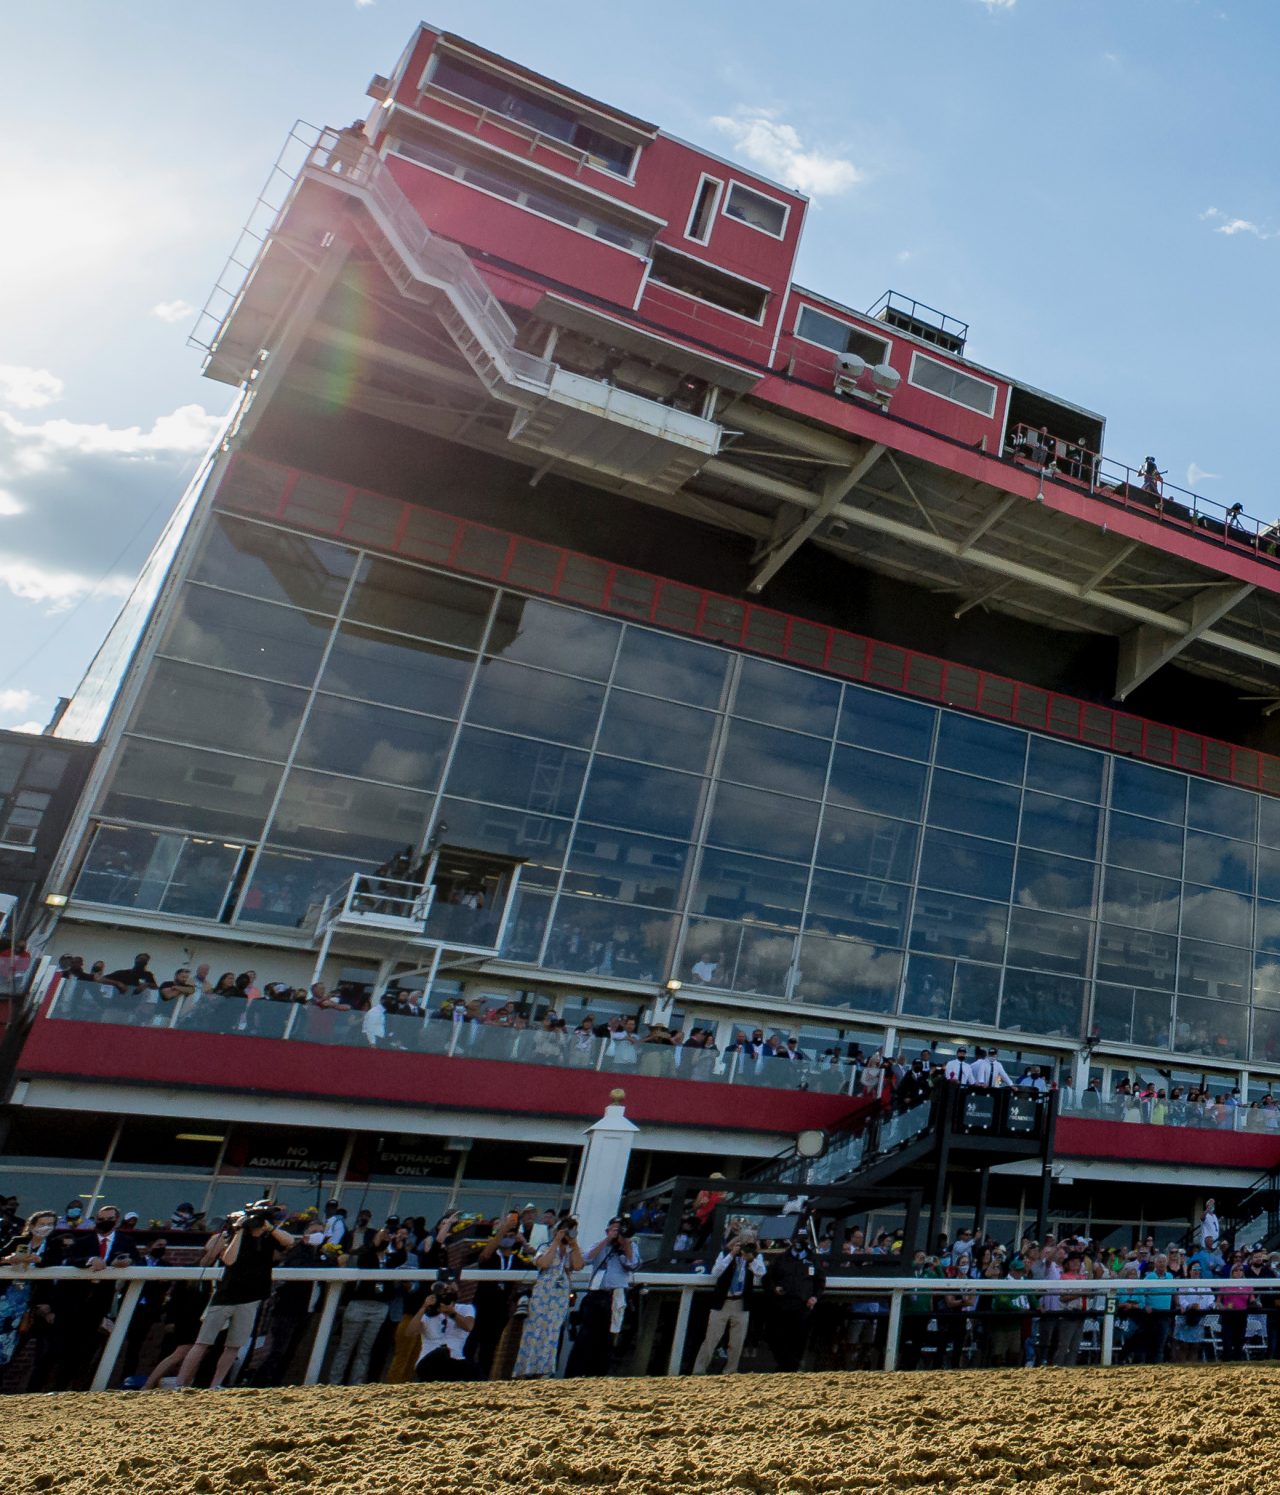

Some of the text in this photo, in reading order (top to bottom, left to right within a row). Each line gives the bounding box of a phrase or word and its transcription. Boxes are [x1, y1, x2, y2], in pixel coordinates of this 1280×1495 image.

[286, 1146, 309, 1156] NO
[249, 1157, 339, 1171] ADMITTANCE
[380, 1152, 452, 1166] ENTRANCE
[395, 1165, 431, 1176] ONLY
[1107, 1299, 1116, 1313] 5
